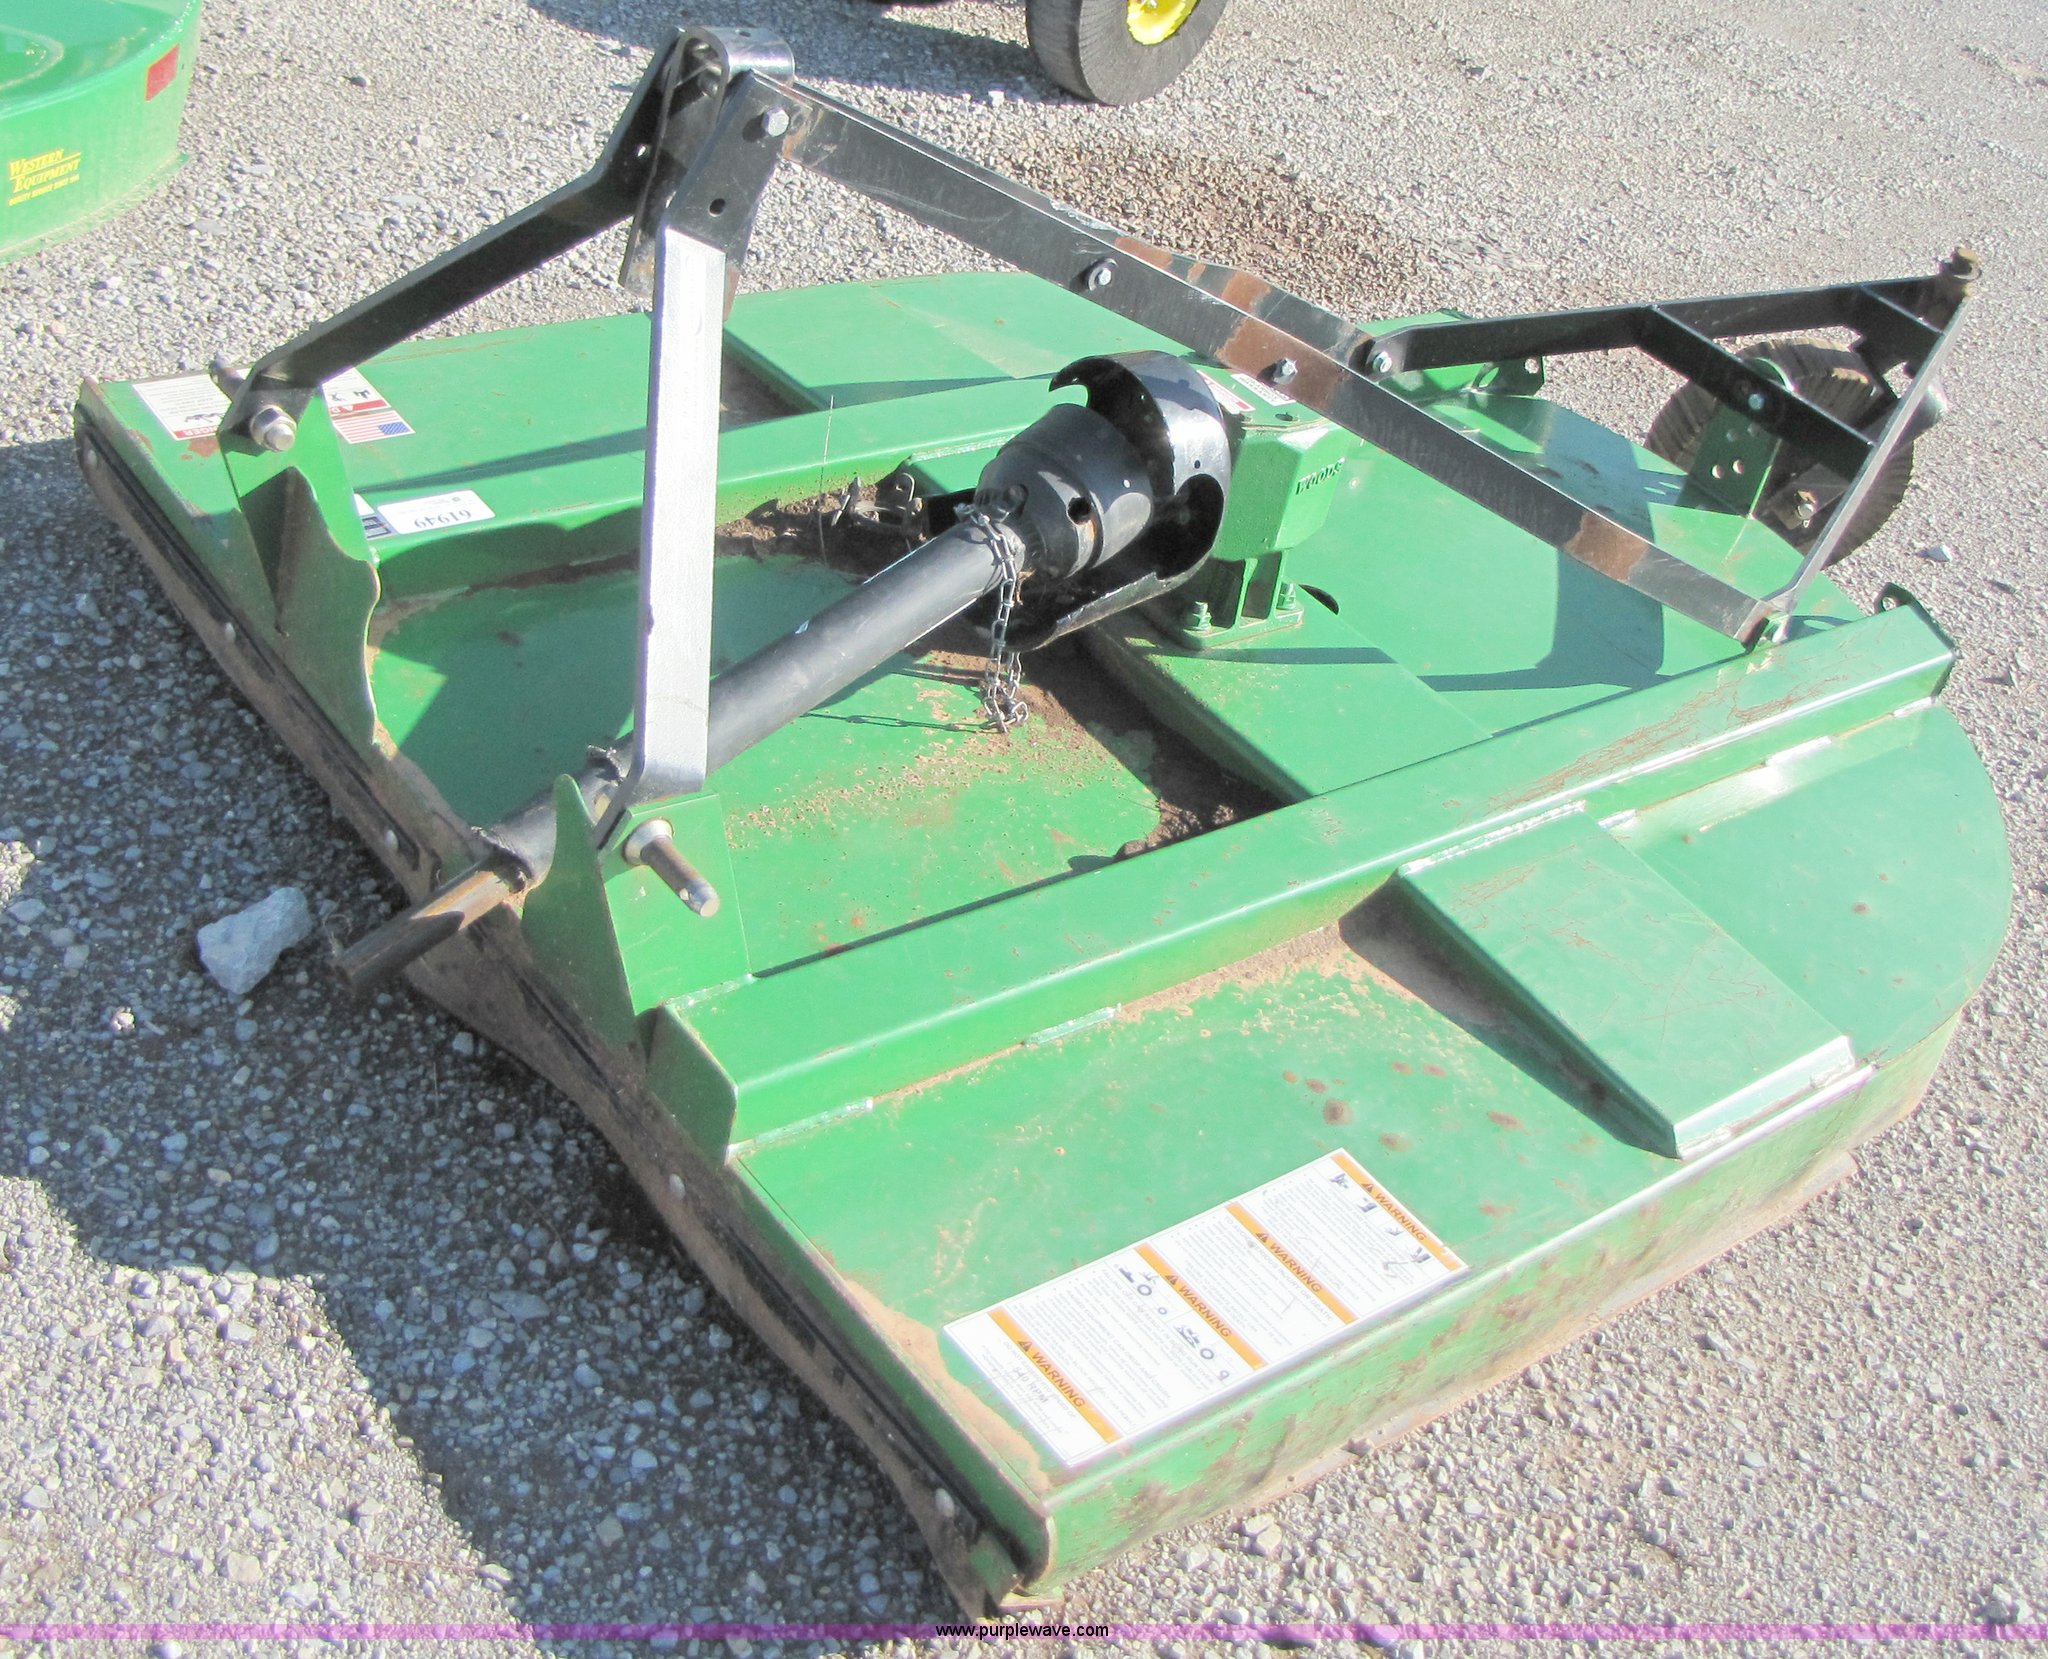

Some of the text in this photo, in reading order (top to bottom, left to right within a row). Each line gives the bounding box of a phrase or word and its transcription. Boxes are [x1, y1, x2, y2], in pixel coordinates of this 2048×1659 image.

[9, 147, 64, 177] WESTERN
[13, 157, 81, 193] EQUIPMENT
[1295, 458, 1345, 496] WOODS
[414, 509, 472, 529] 61949
[1374, 1193, 1426, 1240] WARNING
[1269, 1242, 1322, 1292] WARNING
[1178, 1285, 1231, 1336] WARNING
[1025, 1382, 1050, 1403] RPM
[1030, 1352, 1085, 1407] WARNING
